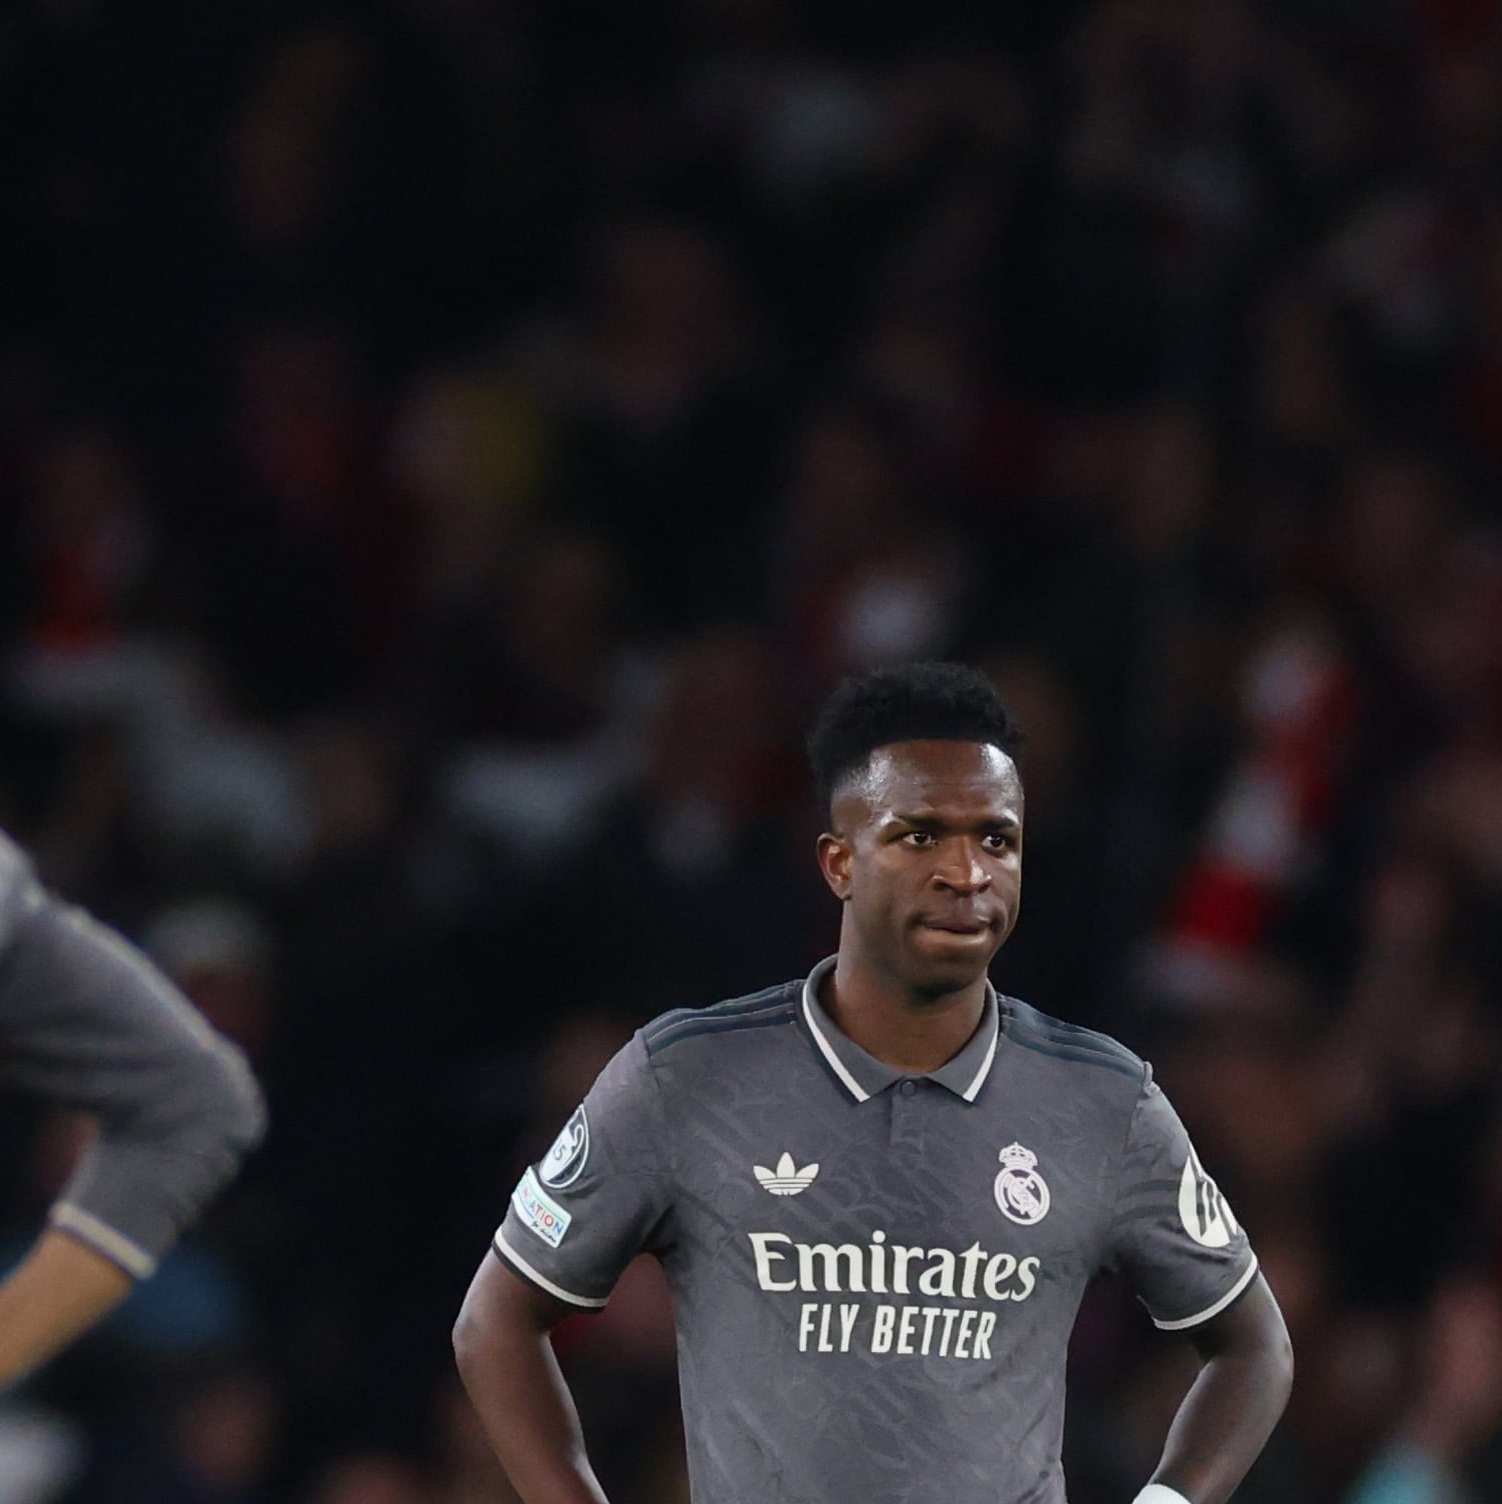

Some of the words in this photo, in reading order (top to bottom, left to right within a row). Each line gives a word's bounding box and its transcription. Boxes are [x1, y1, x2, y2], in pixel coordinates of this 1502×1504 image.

[748, 1230, 1041, 1302] Emirates
[799, 1303, 860, 1352] FLY
[871, 1305, 997, 1360] BETTER
